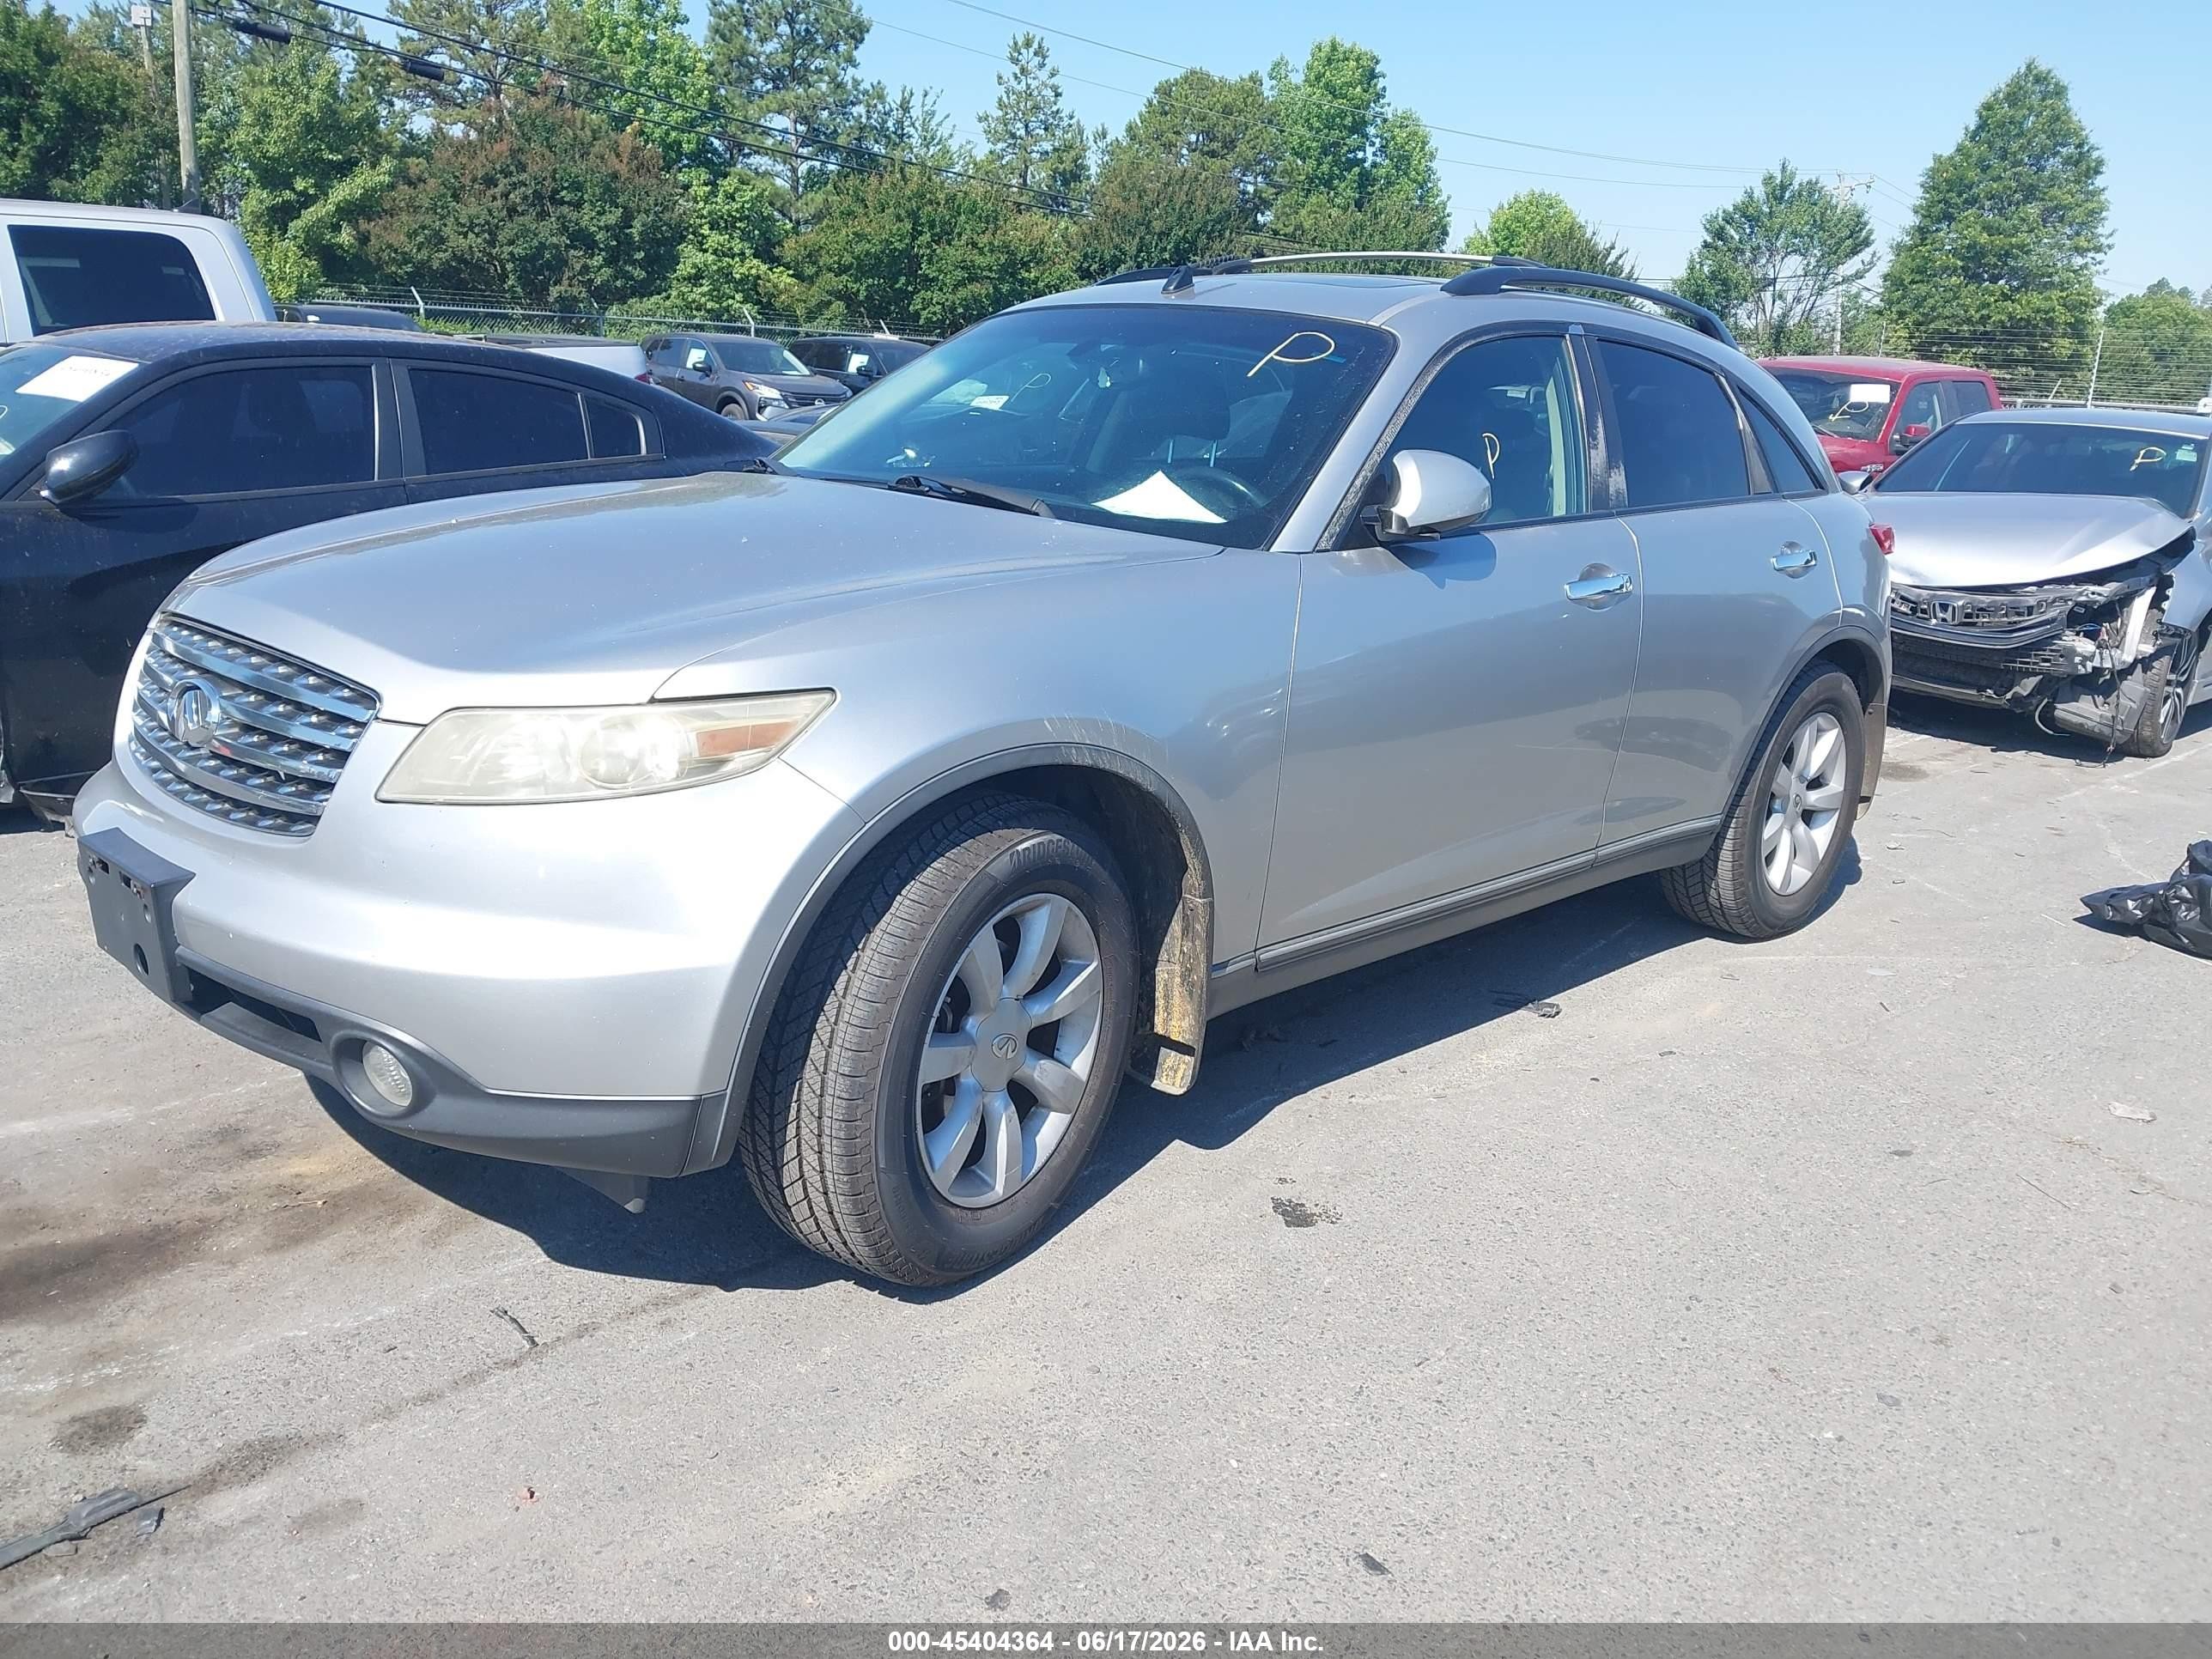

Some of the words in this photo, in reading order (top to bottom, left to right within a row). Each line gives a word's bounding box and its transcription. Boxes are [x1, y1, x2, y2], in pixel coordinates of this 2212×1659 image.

[1246, 331, 1335, 377] P
[1482, 433, 1500, 479] P
[2130, 447, 2166, 471] P
[1009, 838, 1094, 869] BRIDGES
